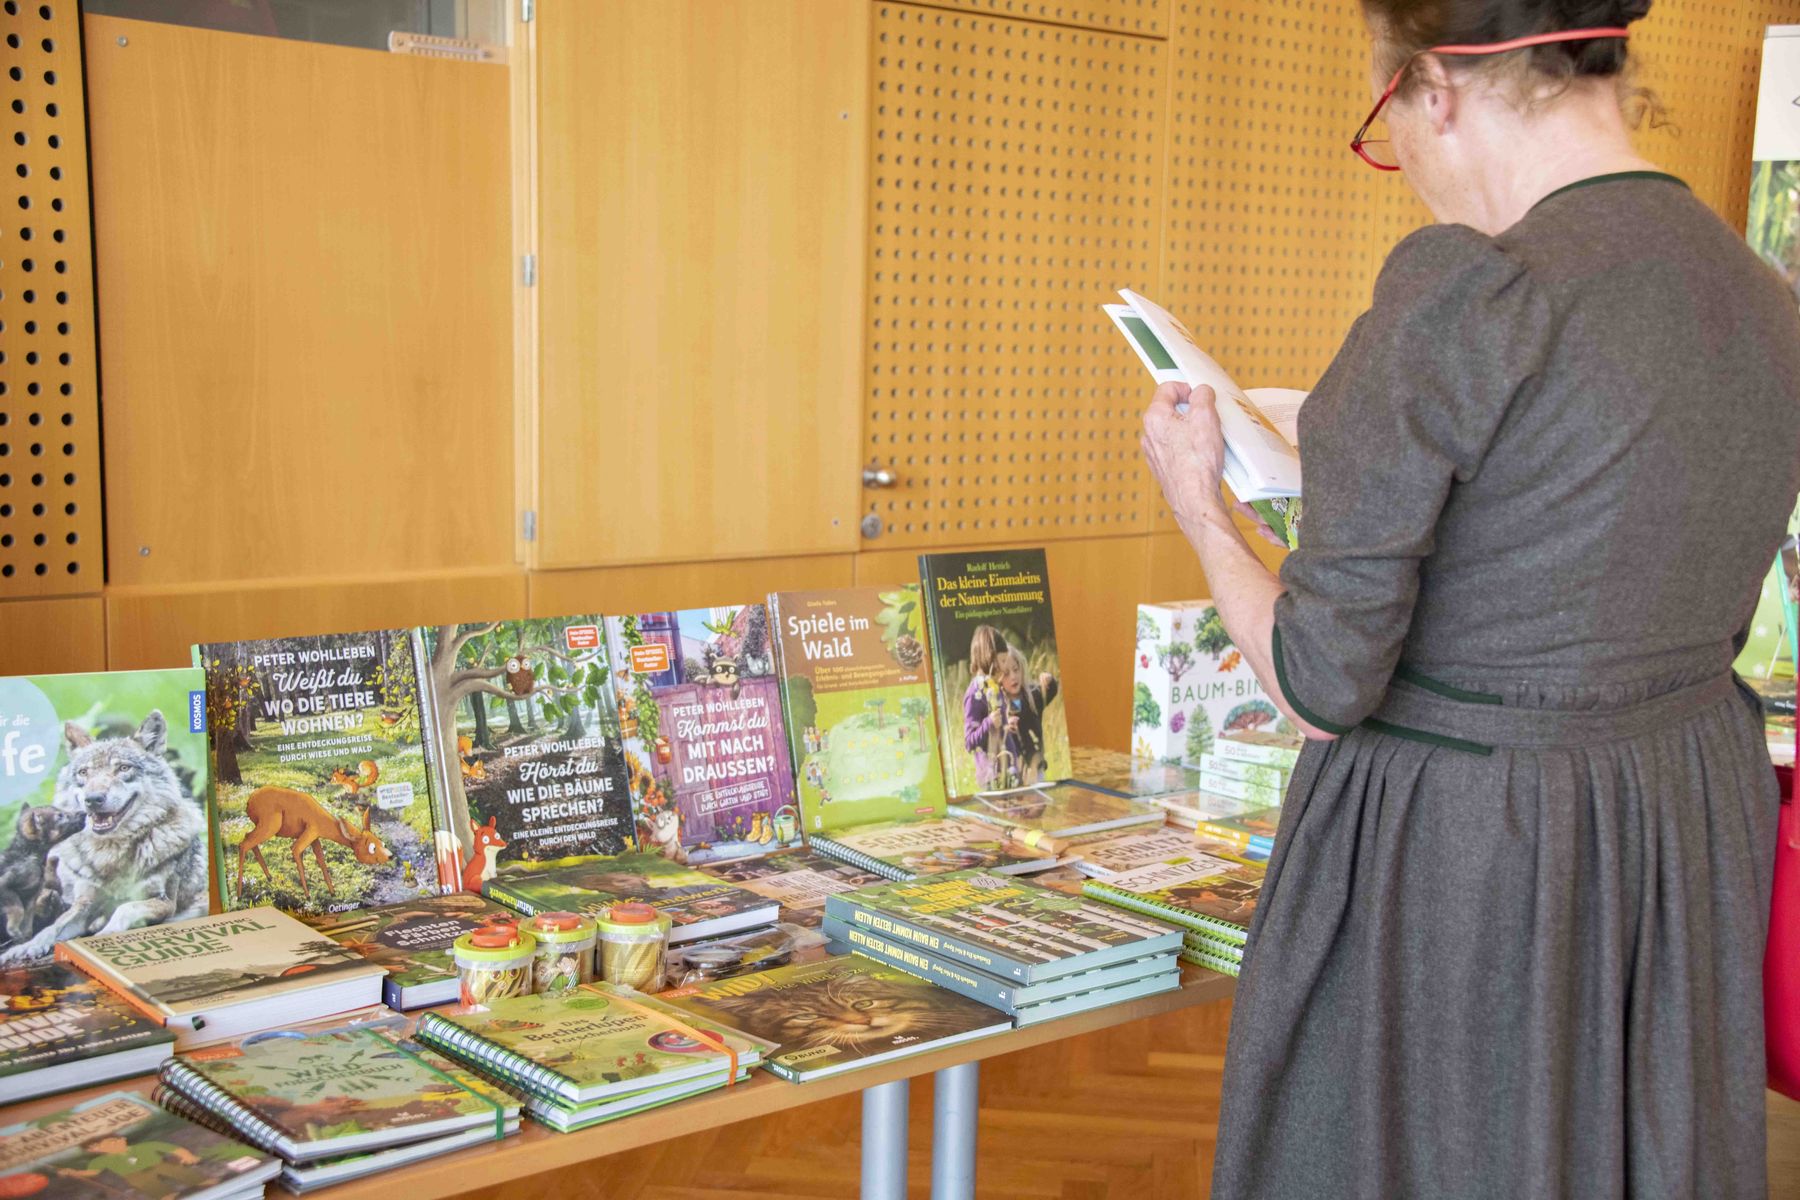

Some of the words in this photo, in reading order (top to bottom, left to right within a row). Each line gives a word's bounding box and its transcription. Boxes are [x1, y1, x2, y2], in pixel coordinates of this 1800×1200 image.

[937, 577, 958, 591] Das
[959, 575, 987, 589] kleine
[989, 571, 1041, 587] Einmaleins
[940, 594, 956, 608] der
[958, 589, 1044, 606] Naturbestimmung
[788, 612, 845, 640] Spiele
[849, 616, 869, 631] im
[254, 652, 295, 667] PETER
[298, 646, 375, 664] WOHLLEBEN
[802, 637, 854, 660] Wald
[273, 669, 335, 694] Weißt
[337, 667, 363, 686] du
[193, 694, 201, 731] KOSMOS
[265, 700, 293, 716] WO
[298, 696, 325, 713] DIE
[328, 691, 375, 709] TIERE
[673, 705, 704, 717] PETER
[706, 697, 765, 714] WOHLLEBEN
[12, 716, 31, 727] die
[281, 714, 364, 736] WOHNEN?
[677, 713, 744, 741] Kommst
[747, 711, 768, 729] du
[277, 744, 296, 752] EINE
[297, 734, 373, 749] ENTDECKUNGSREISE
[504, 745, 538, 758] PETER
[540, 737, 605, 753] WOHLLEBEN
[687, 741, 716, 760] MIT
[721, 734, 764, 756] NACH
[280, 753, 306, 763] DURCH
[309, 750, 332, 760] WIESE
[333, 748, 349, 757] UND
[351, 745, 372, 755] WALD
[519, 757, 574, 785] Hörst
[576, 756, 598, 774] du
[683, 755, 775, 783] DRAUSSEN?
[507, 787, 535, 804] WIE
[538, 784, 562, 801] DIE
[564, 777, 614, 797] BÄUME
[521, 798, 604, 822] SPRECHEN?
[513, 831, 529, 840] EINE
[530, 827, 553, 837] KLEINE
[554, 818, 618, 834] ENTDECKUNGSREISE
[539, 837, 562, 846] DURCH
[564, 834, 577, 843] DEN
[578, 831, 596, 841] WALD
[856, 825, 971, 848] SCHNITZ
[1090, 836, 1193, 860] SCHNITZ
[1114, 856, 1231, 889] SCHNITZEN
[650, 886, 731, 908] andwerk
[328, 902, 360, 914] Oetinger
[855, 910, 873, 925] ALLEIN
[89, 934, 157, 949] NATIONAL
[162, 916, 252, 937] GEOGRAPHIC
[384, 920, 460, 937] Flechten
[400, 926, 462, 940] Färben
[873, 916, 892, 933] SELTEN
[893, 925, 913, 942] KOMMT
[83, 935, 112, 946] DER
[115, 926, 174, 941] GROSSE
[96, 920, 277, 956] SURVIVAL
[849, 929, 866, 944] ALLEIN
[866, 936, 885, 953] SELTEN
[912, 932, 929, 946] BAUM
[929, 936, 940, 948] EIN
[111, 938, 231, 966] GUIDE
[884, 944, 903, 961] KOMMT
[902, 953, 919, 967] BAUM
[918, 958, 929, 971] EIN
[561, 1018, 589, 1028] Das
[551, 1022, 646, 1045] Forscherbuch
[797, 1047, 826, 1060] BUND
[286, 1062, 368, 1079] WALD
